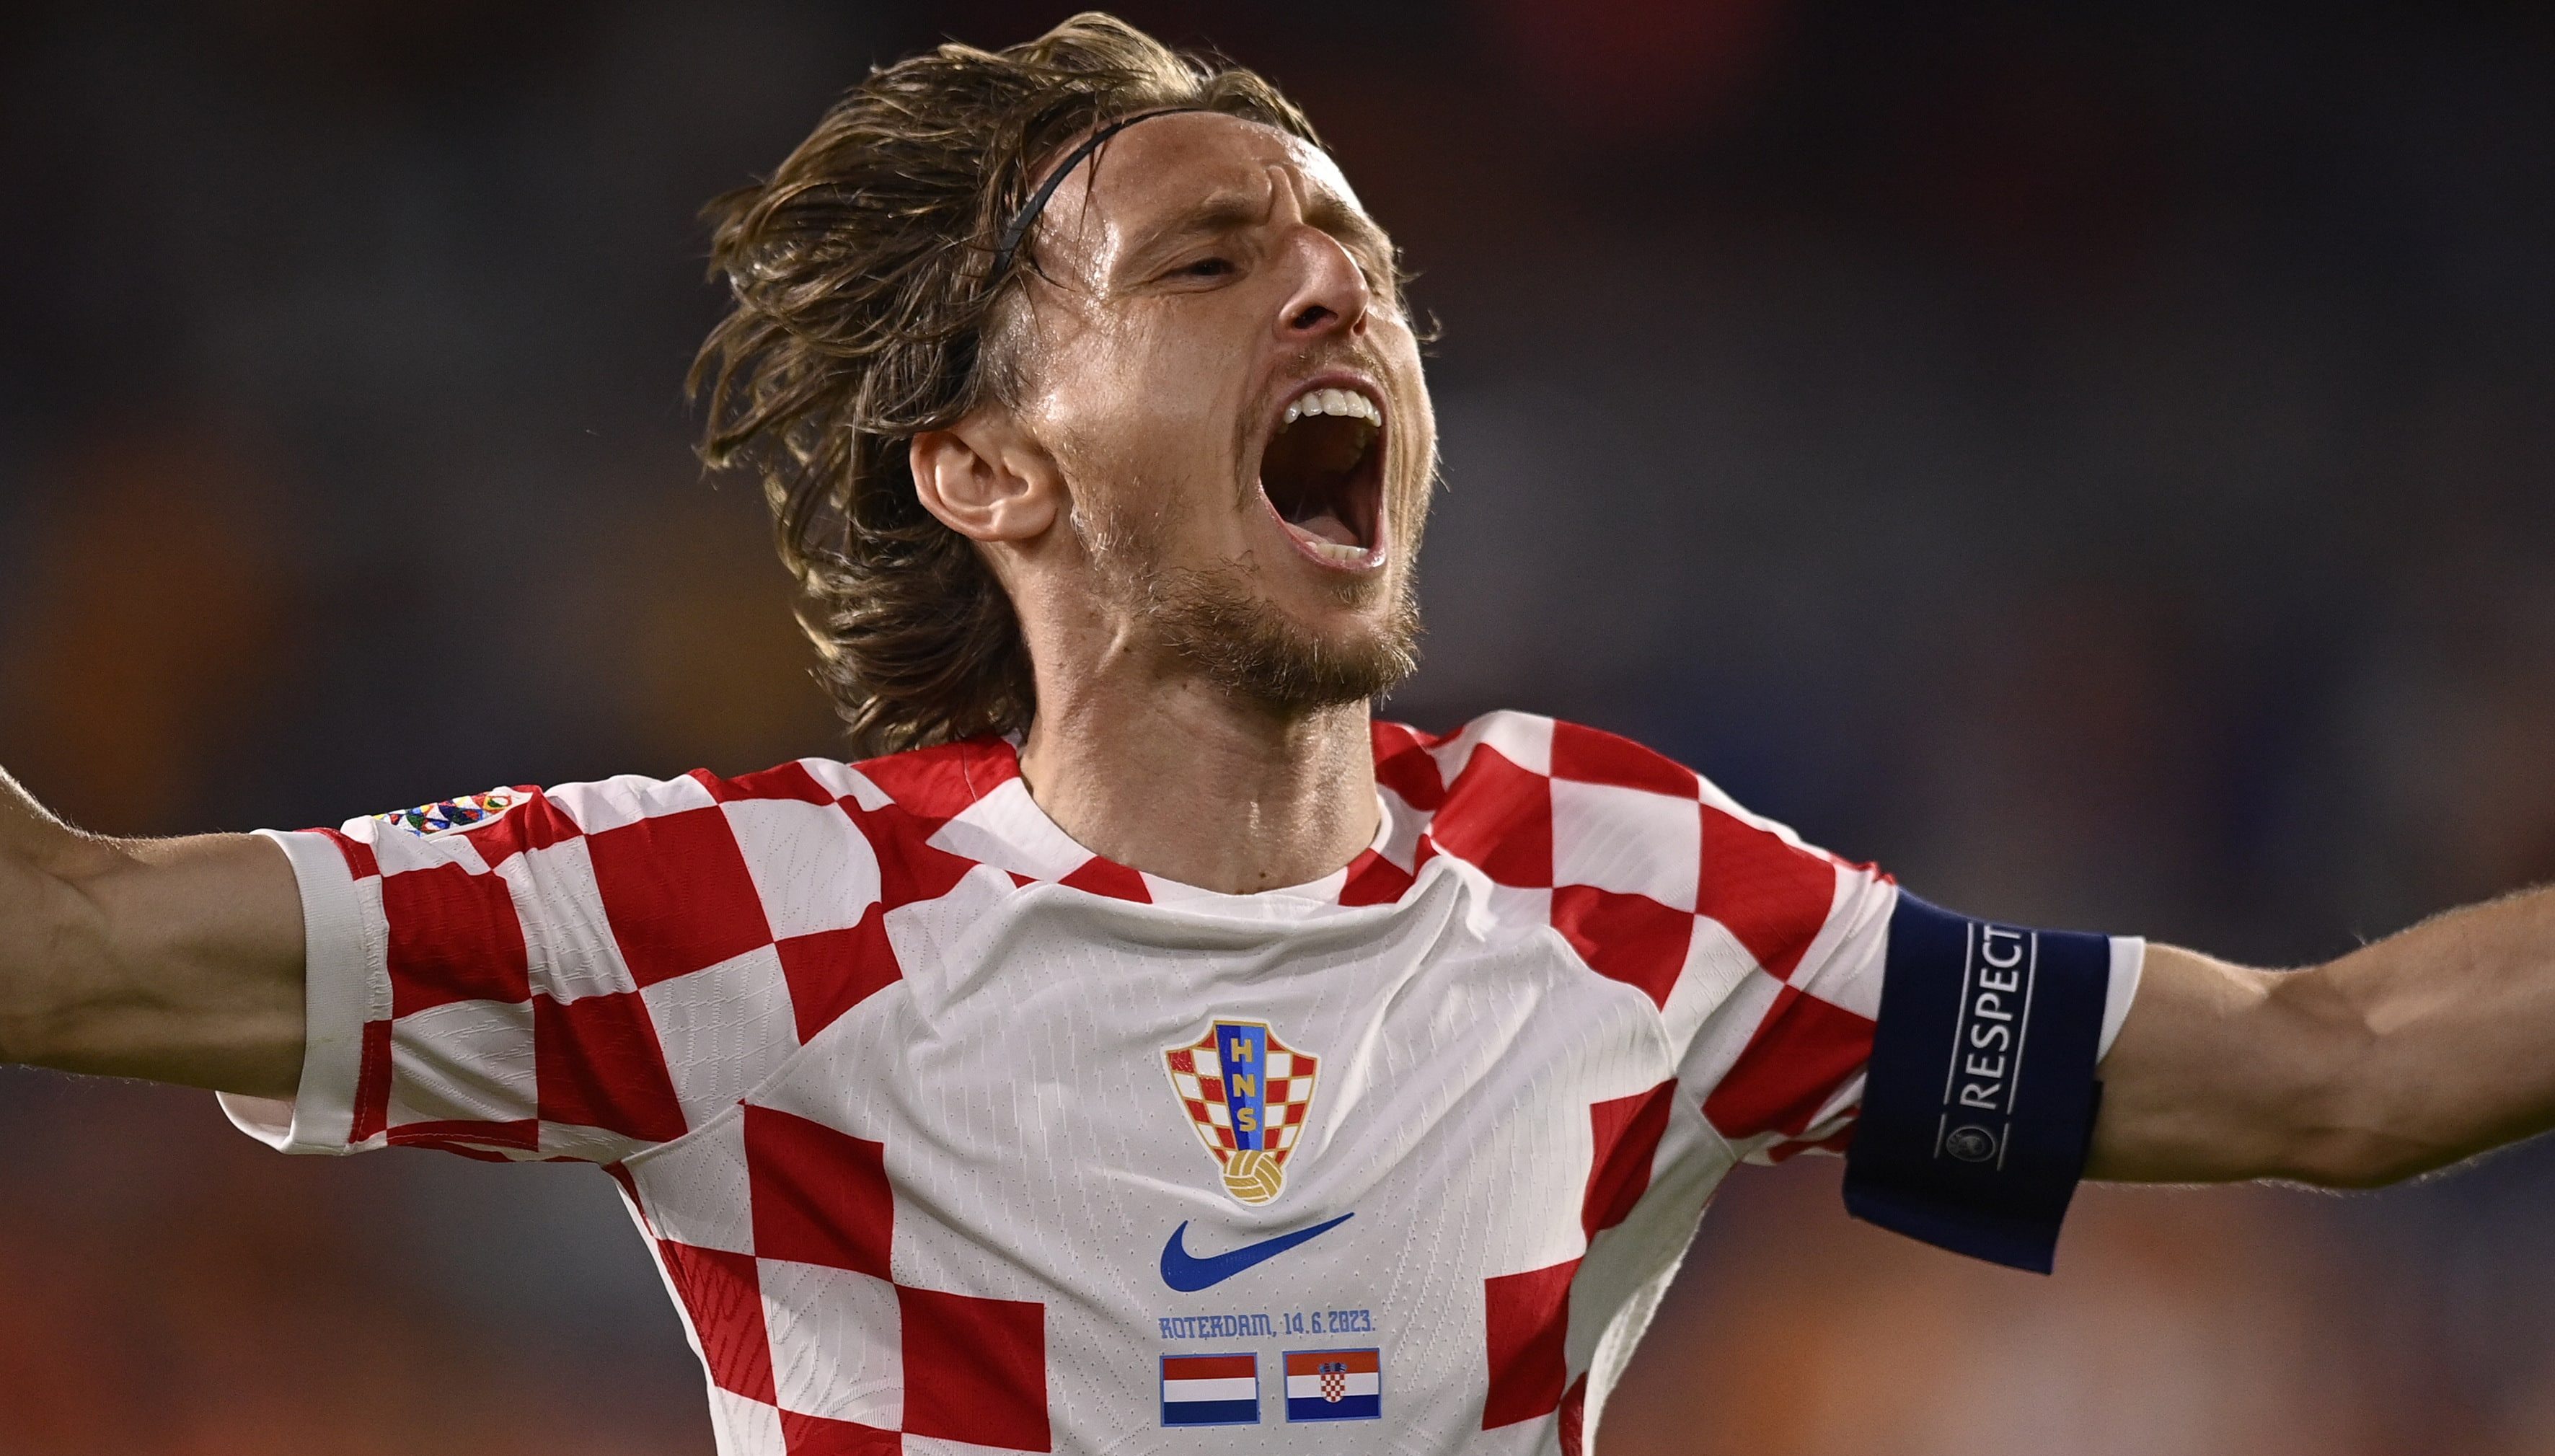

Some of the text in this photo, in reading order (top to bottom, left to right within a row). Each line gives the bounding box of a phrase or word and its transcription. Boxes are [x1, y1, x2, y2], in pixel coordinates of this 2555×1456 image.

[1959, 925, 2022, 1111] RESPECT
[1230, 1038, 1256, 1132] HNS
[1158, 1310, 1376, 1339] ROTERDAM, 14.6.2023.
